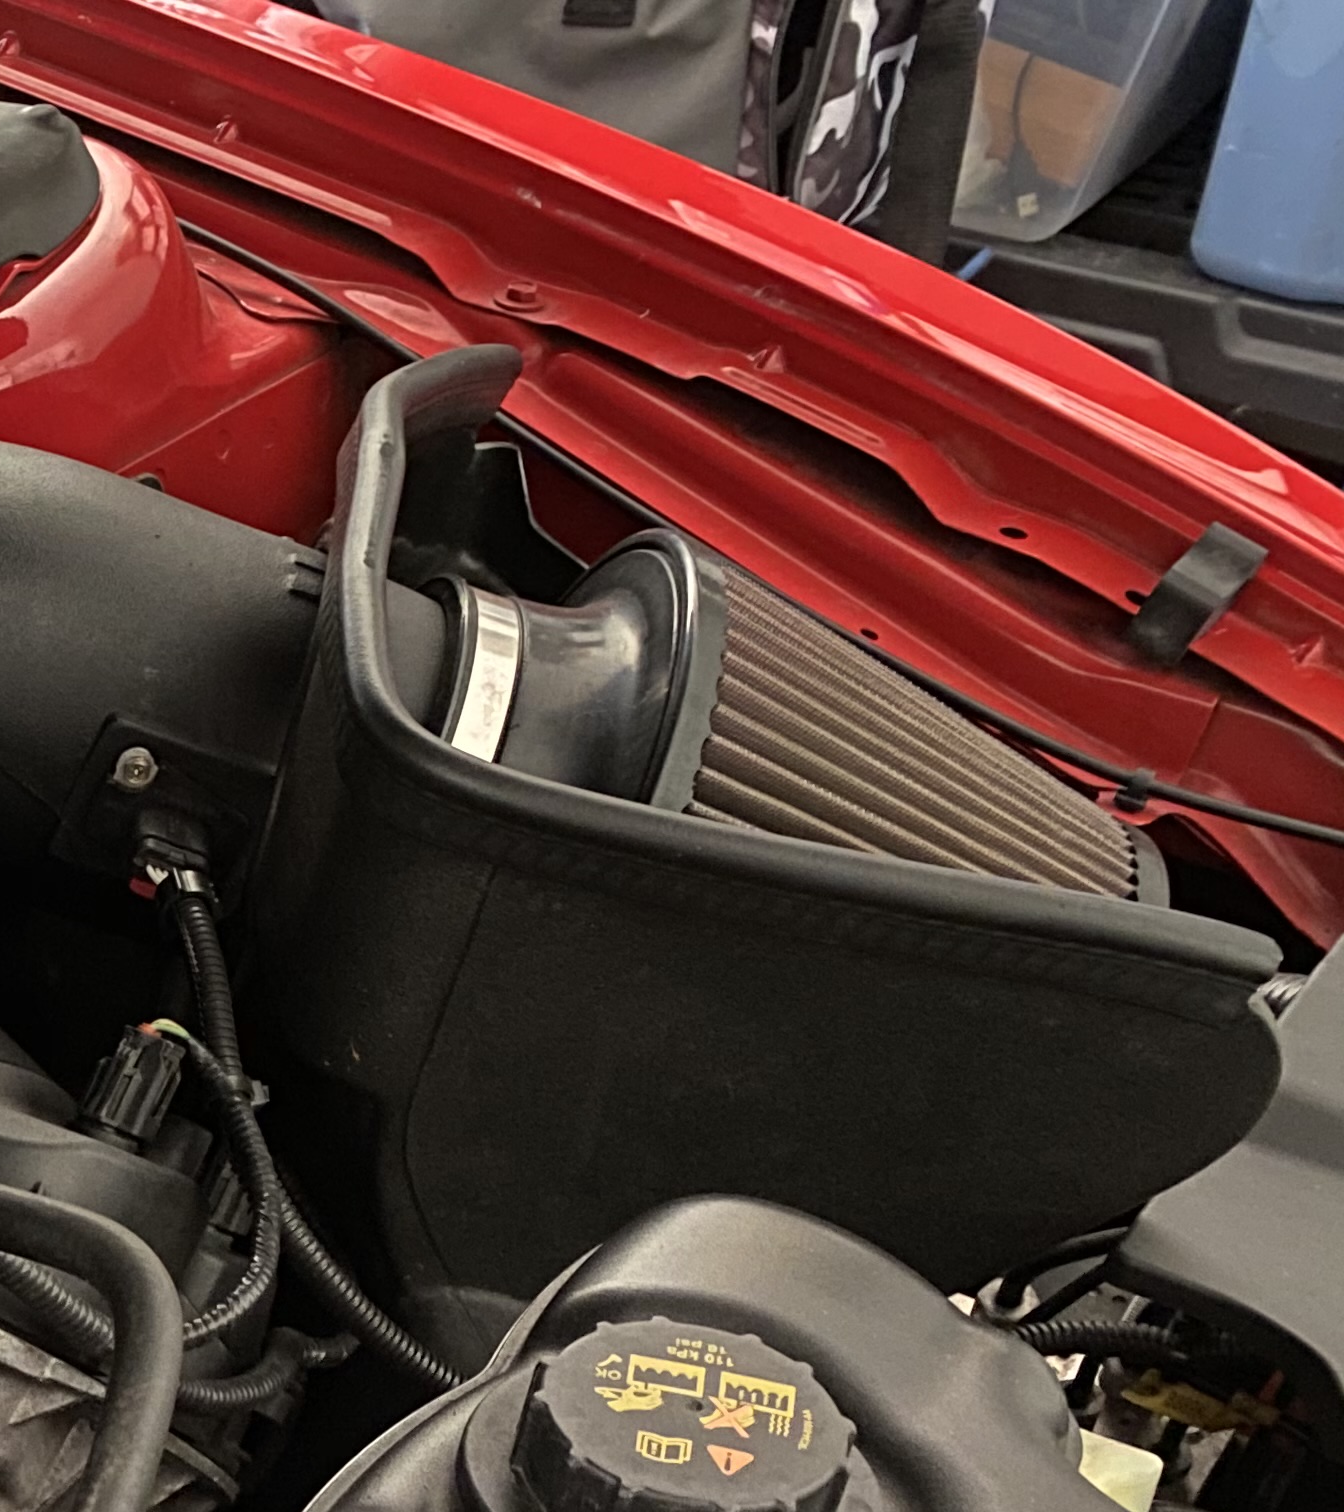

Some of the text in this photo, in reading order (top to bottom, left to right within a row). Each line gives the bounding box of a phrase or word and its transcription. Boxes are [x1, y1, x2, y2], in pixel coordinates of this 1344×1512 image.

[666, 1345, 735, 1368] 110 kPa
[594, 1366, 623, 1381] OK
